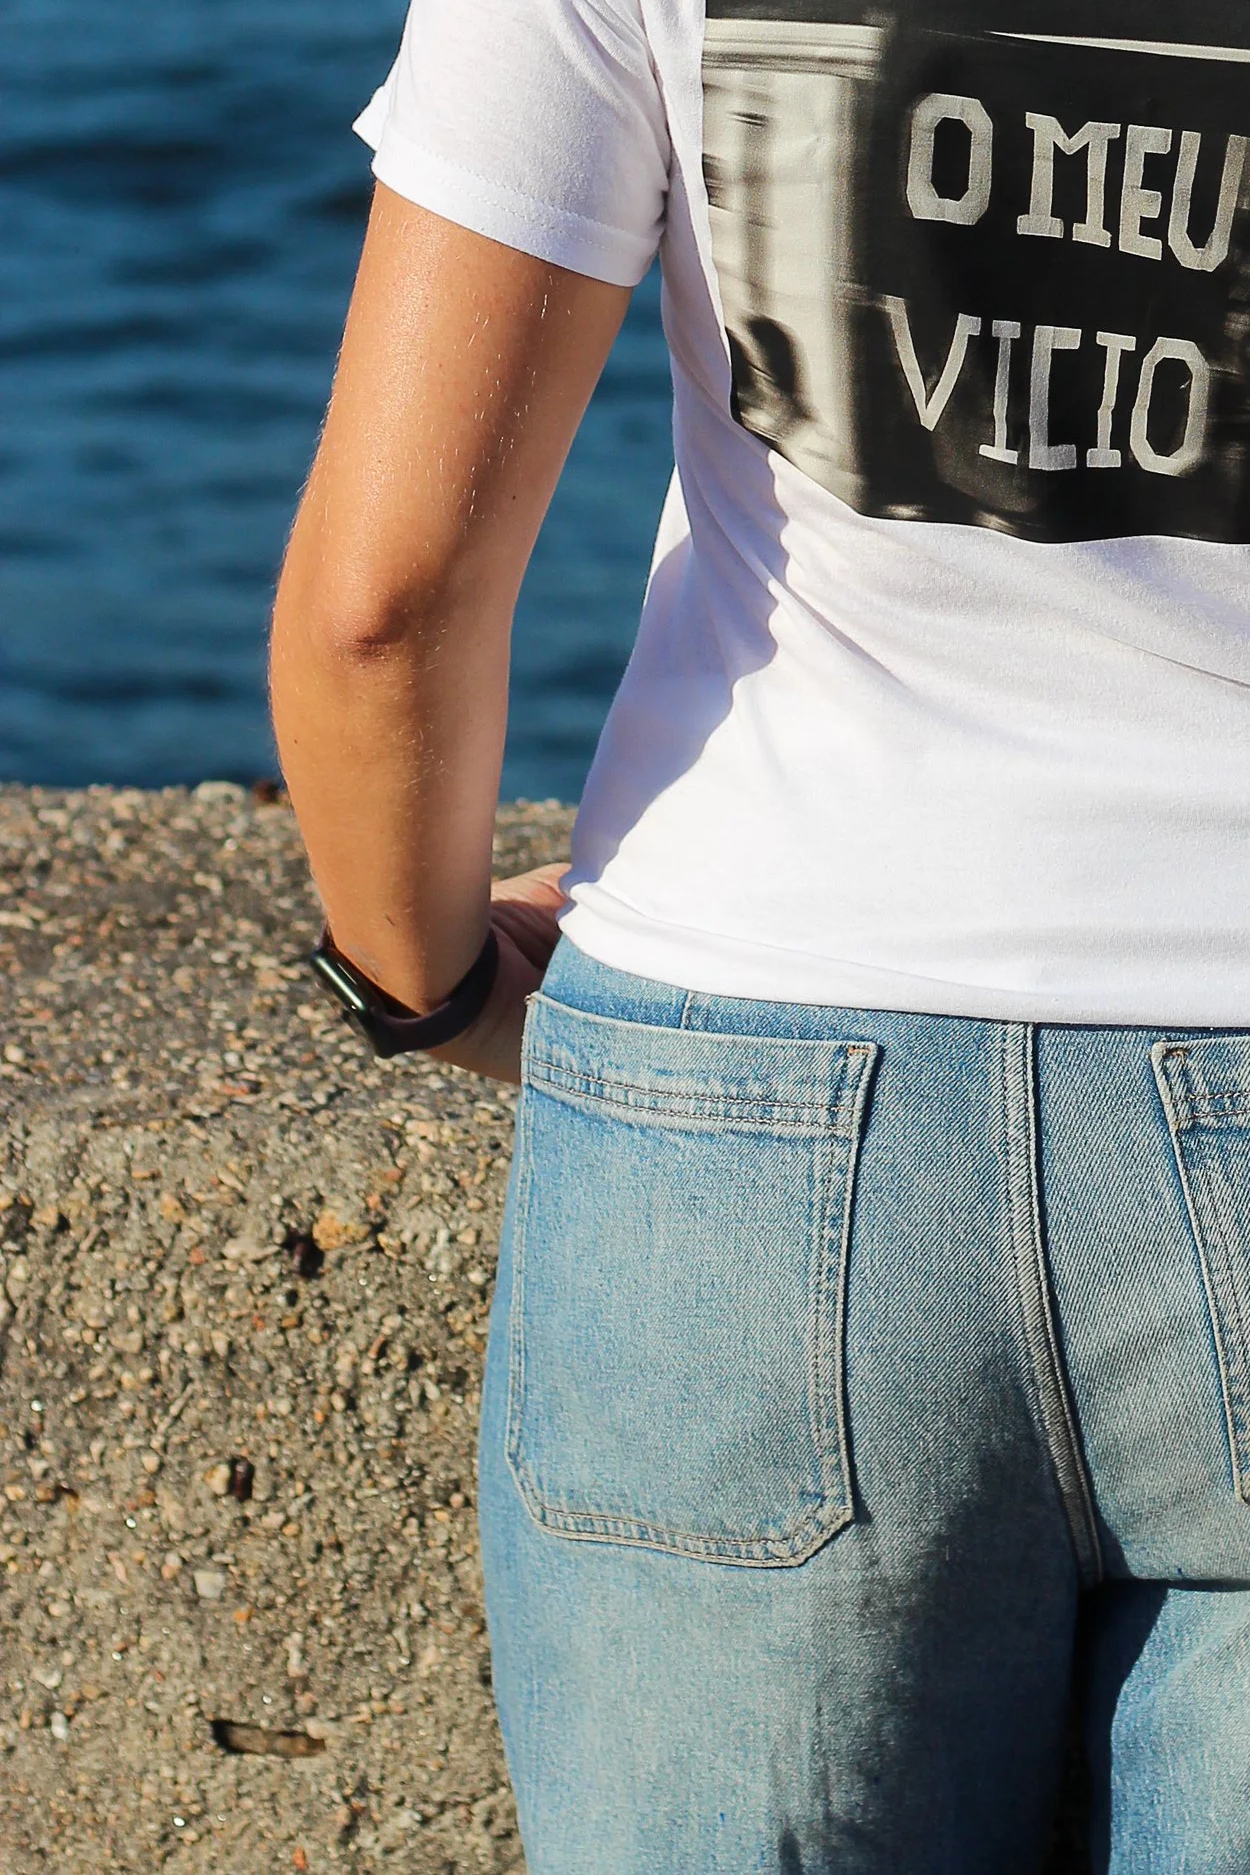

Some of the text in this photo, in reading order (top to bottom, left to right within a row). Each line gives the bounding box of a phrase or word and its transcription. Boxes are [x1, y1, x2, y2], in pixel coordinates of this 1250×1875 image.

[906, 93, 1248, 272] O MEU
[882, 294, 1210, 477] VICIO
